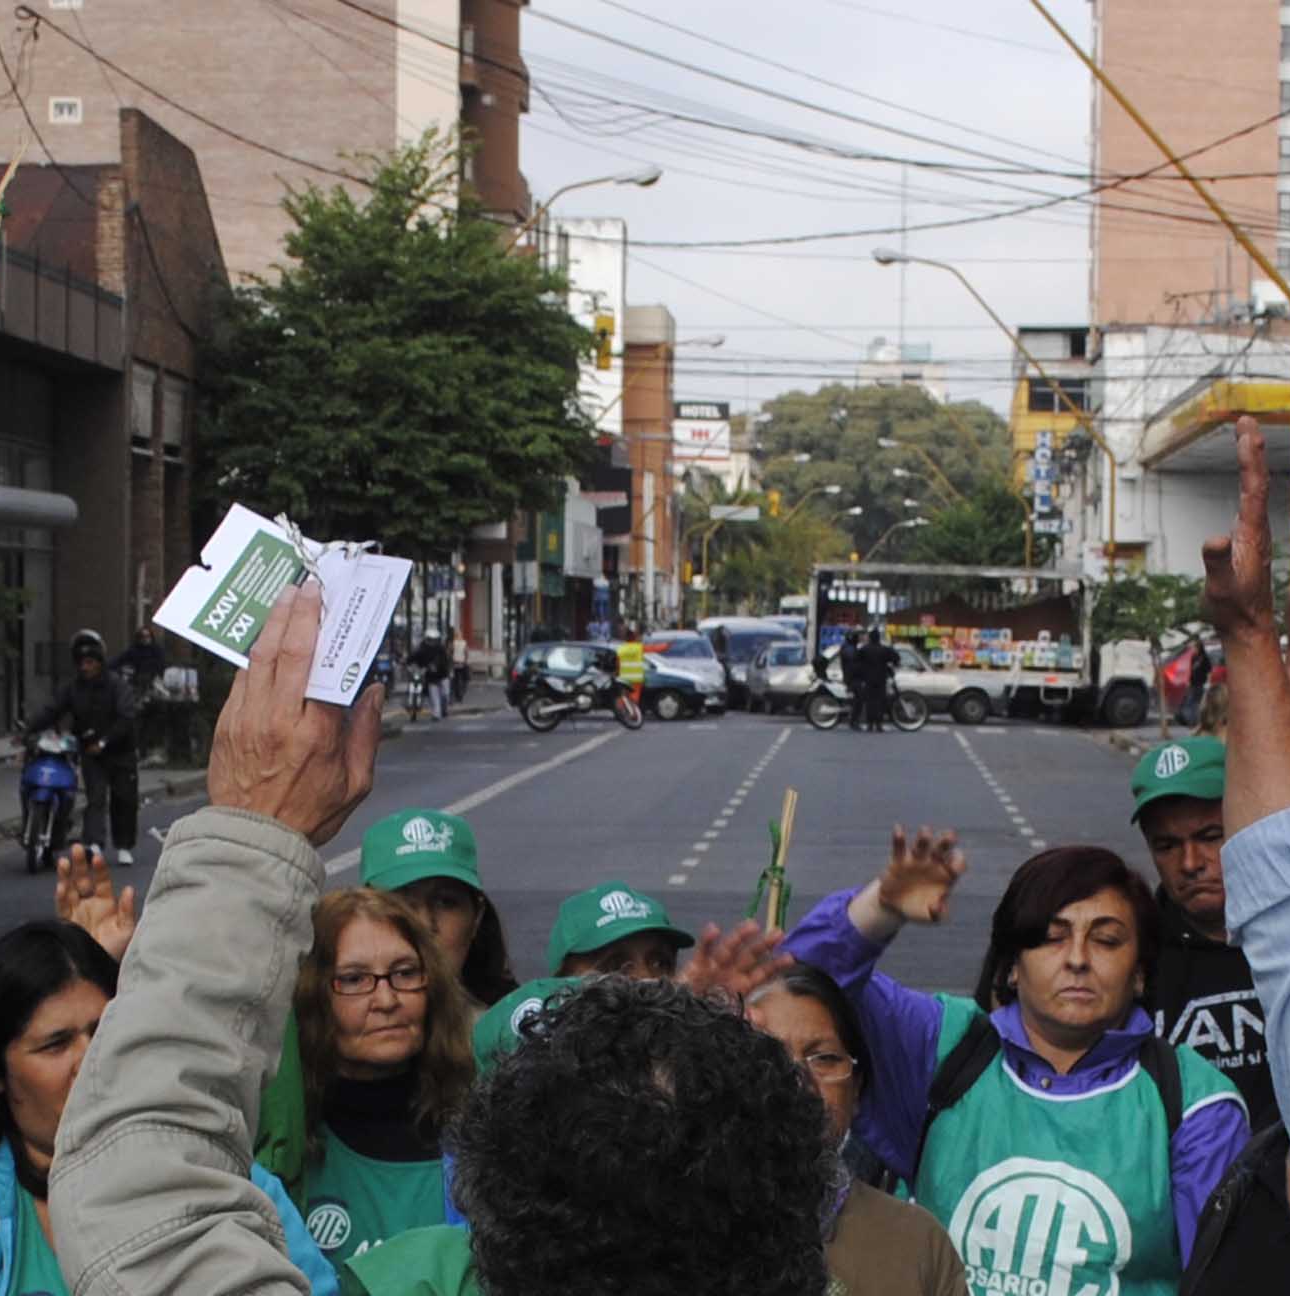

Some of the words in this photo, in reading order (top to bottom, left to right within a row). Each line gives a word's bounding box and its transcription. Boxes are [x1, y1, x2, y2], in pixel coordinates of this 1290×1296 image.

[203, 588, 240, 631] XXIV
[227, 611, 256, 643] XXI
[310, 1207, 348, 1246] ATE
